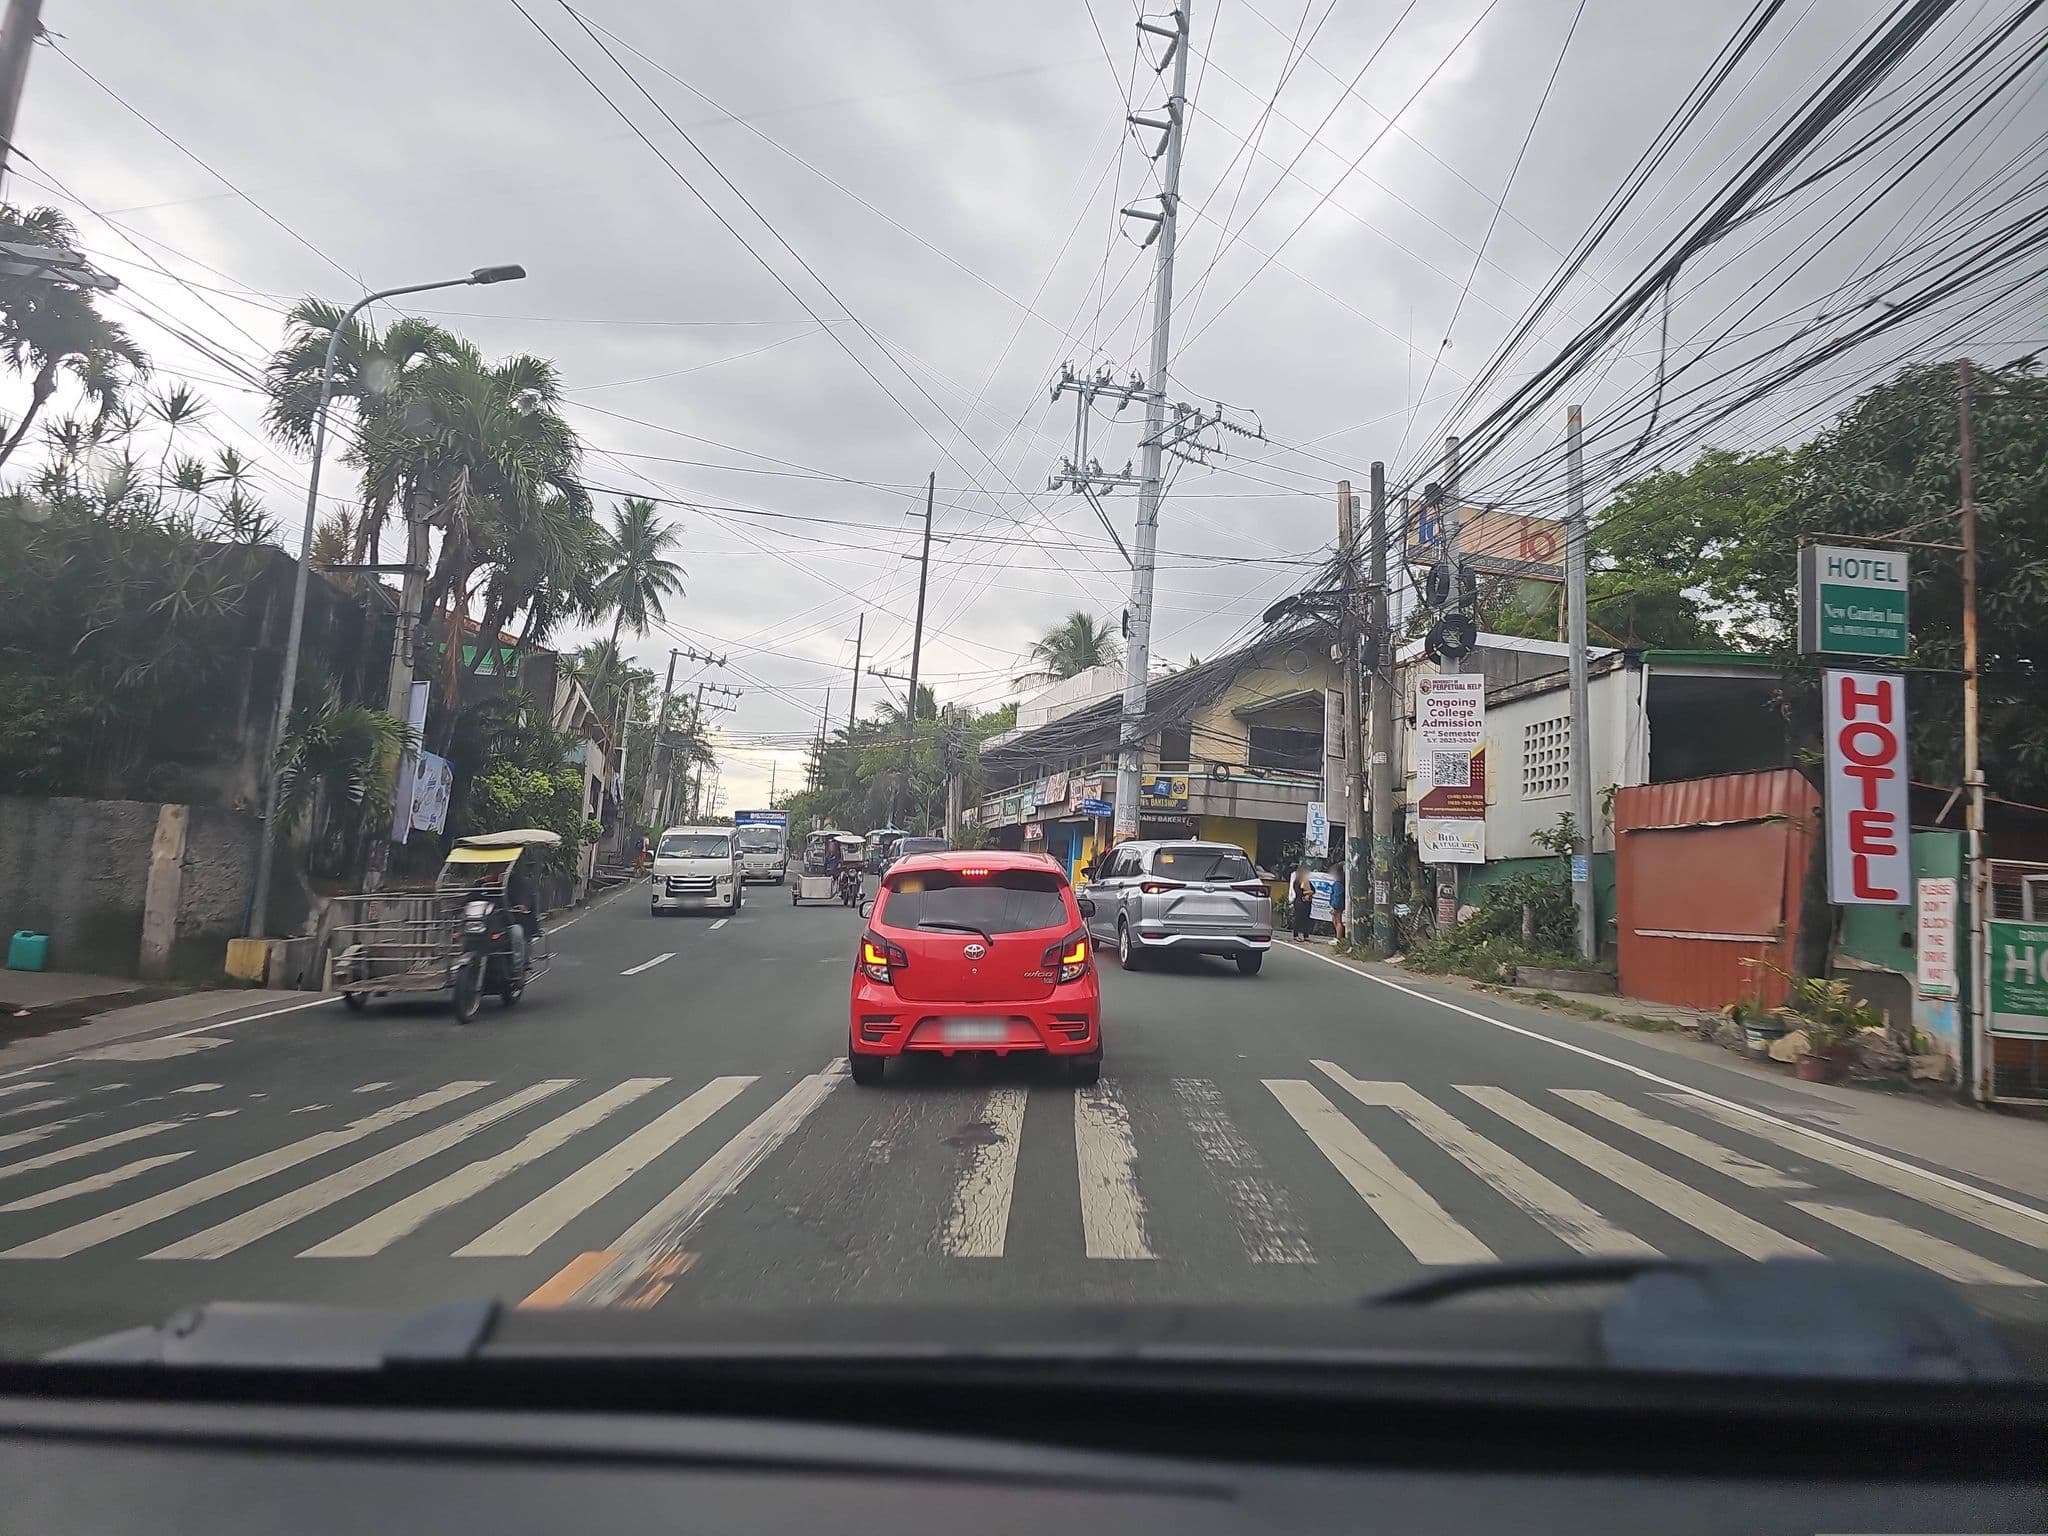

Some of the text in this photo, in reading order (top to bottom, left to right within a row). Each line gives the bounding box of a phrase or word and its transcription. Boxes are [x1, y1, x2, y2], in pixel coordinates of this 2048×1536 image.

[1828, 556, 1899, 583] HOTEL
[1426, 698, 1477, 708] Ongoing
[1429, 708, 1474, 718] College
[1421, 719, 1482, 728] Admission
[1839, 677, 1898, 900] HOTEL
[1157, 815, 1187, 823] BAKERY
[1920, 884, 1952, 896] PLEASE
[2004, 944, 2048, 985] H
